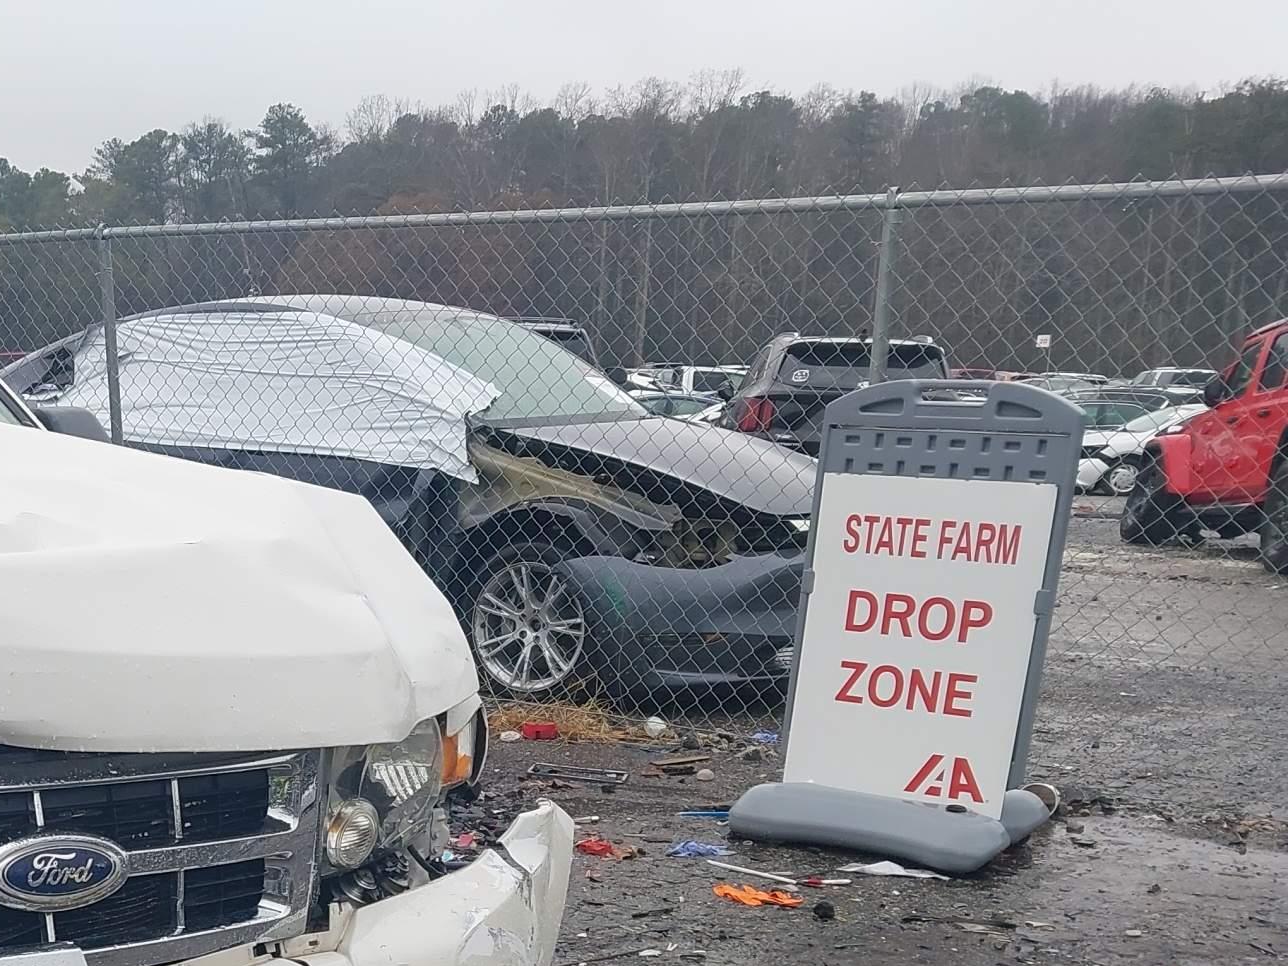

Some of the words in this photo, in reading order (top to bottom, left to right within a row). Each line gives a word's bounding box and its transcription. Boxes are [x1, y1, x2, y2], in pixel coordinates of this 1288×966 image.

[842, 513, 931, 559] STATE
[937, 520, 1022, 565] FARM
[844, 589, 994, 643] DROP
[834, 660, 978, 718] ZONE
[26, 852, 94, 888] Ford
